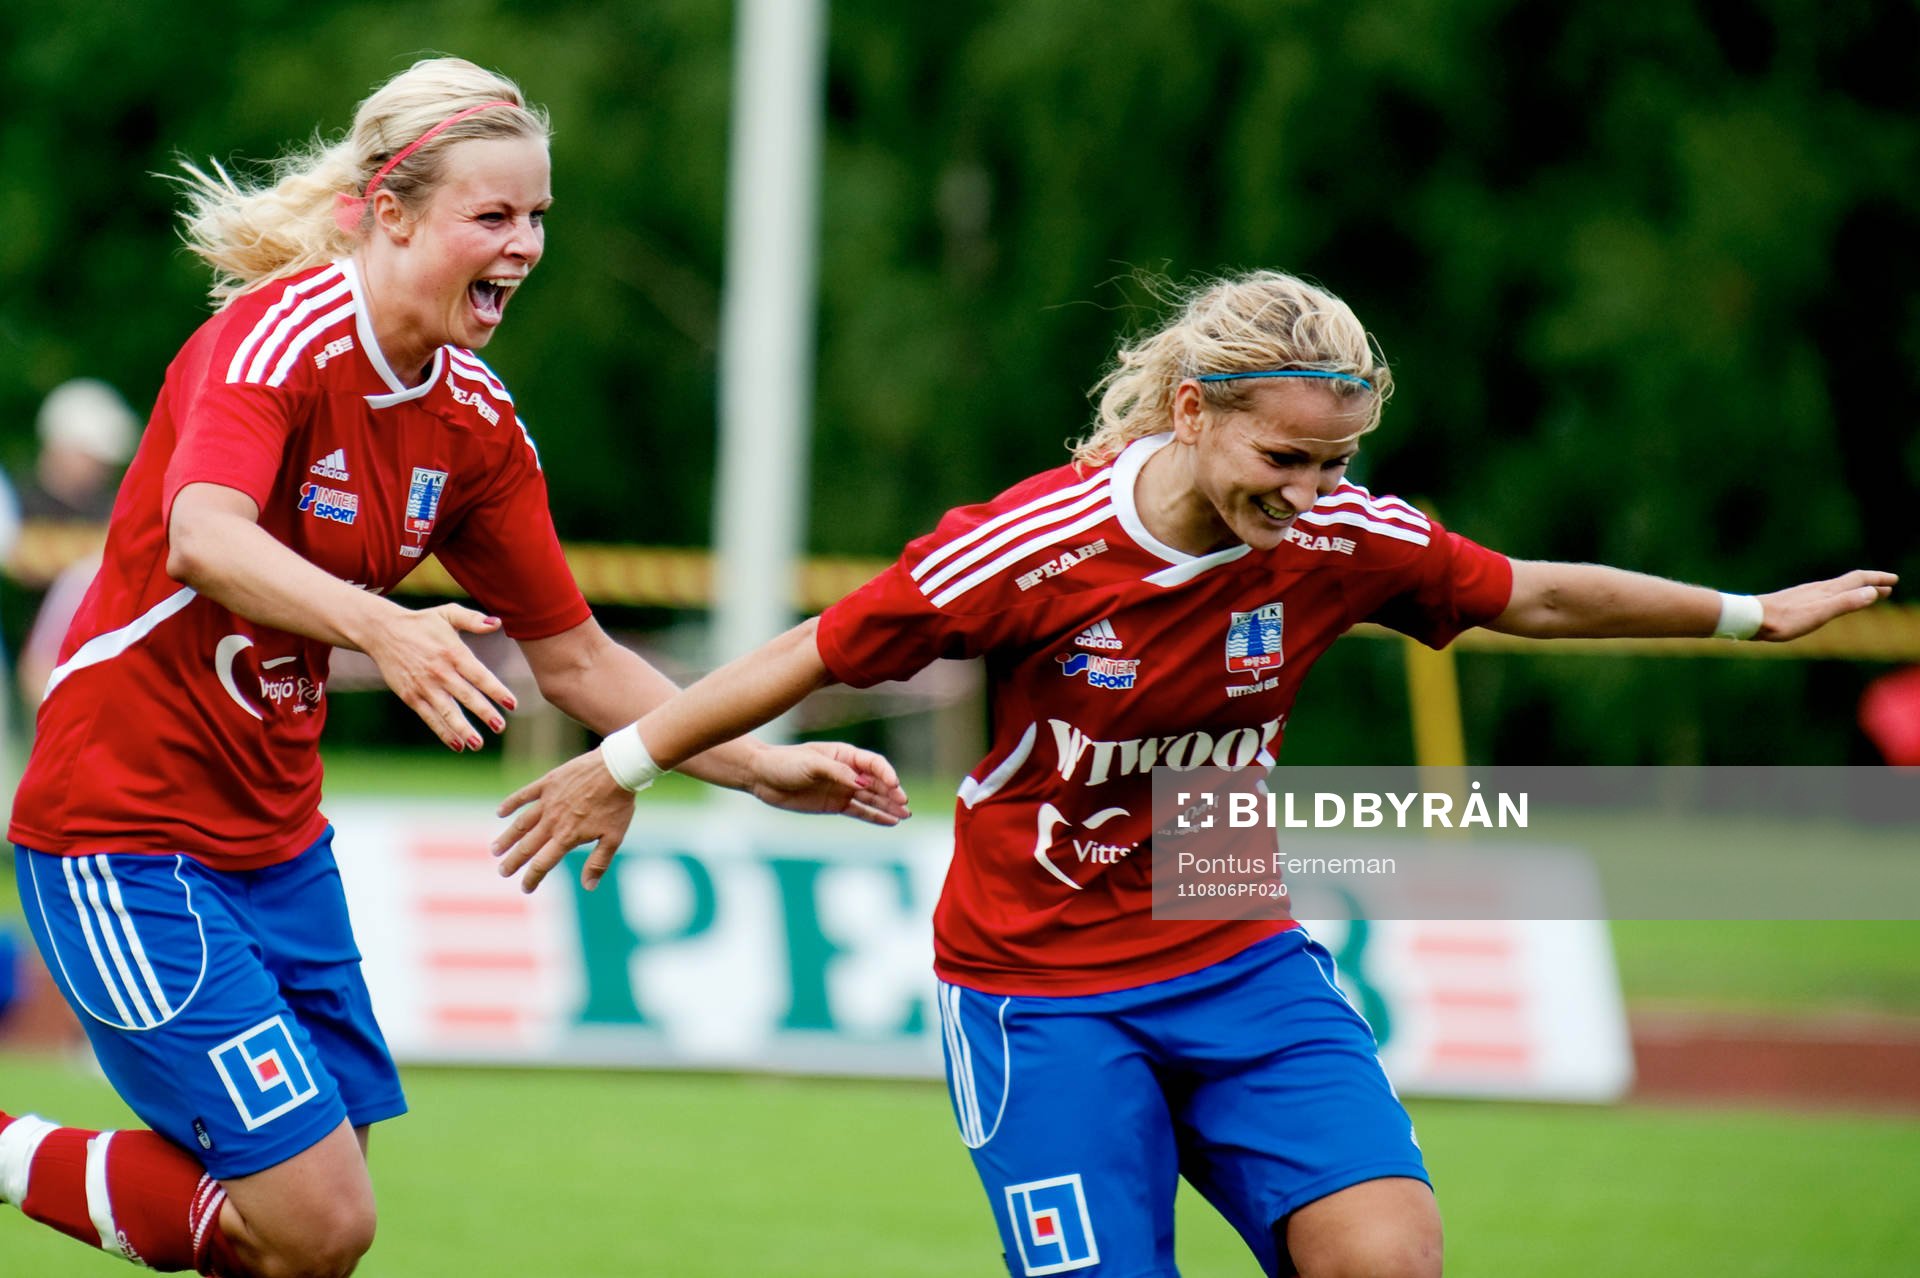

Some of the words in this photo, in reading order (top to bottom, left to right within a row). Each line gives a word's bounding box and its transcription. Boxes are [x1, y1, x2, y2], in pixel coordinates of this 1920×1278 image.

[310, 464, 350, 481] adidas
[314, 502, 356, 524] SPORT
[1024, 544, 1097, 587] PEAB
[1074, 635, 1123, 650] adidas
[1090, 655, 1137, 676] INTER
[1088, 671, 1135, 690] SPORT
